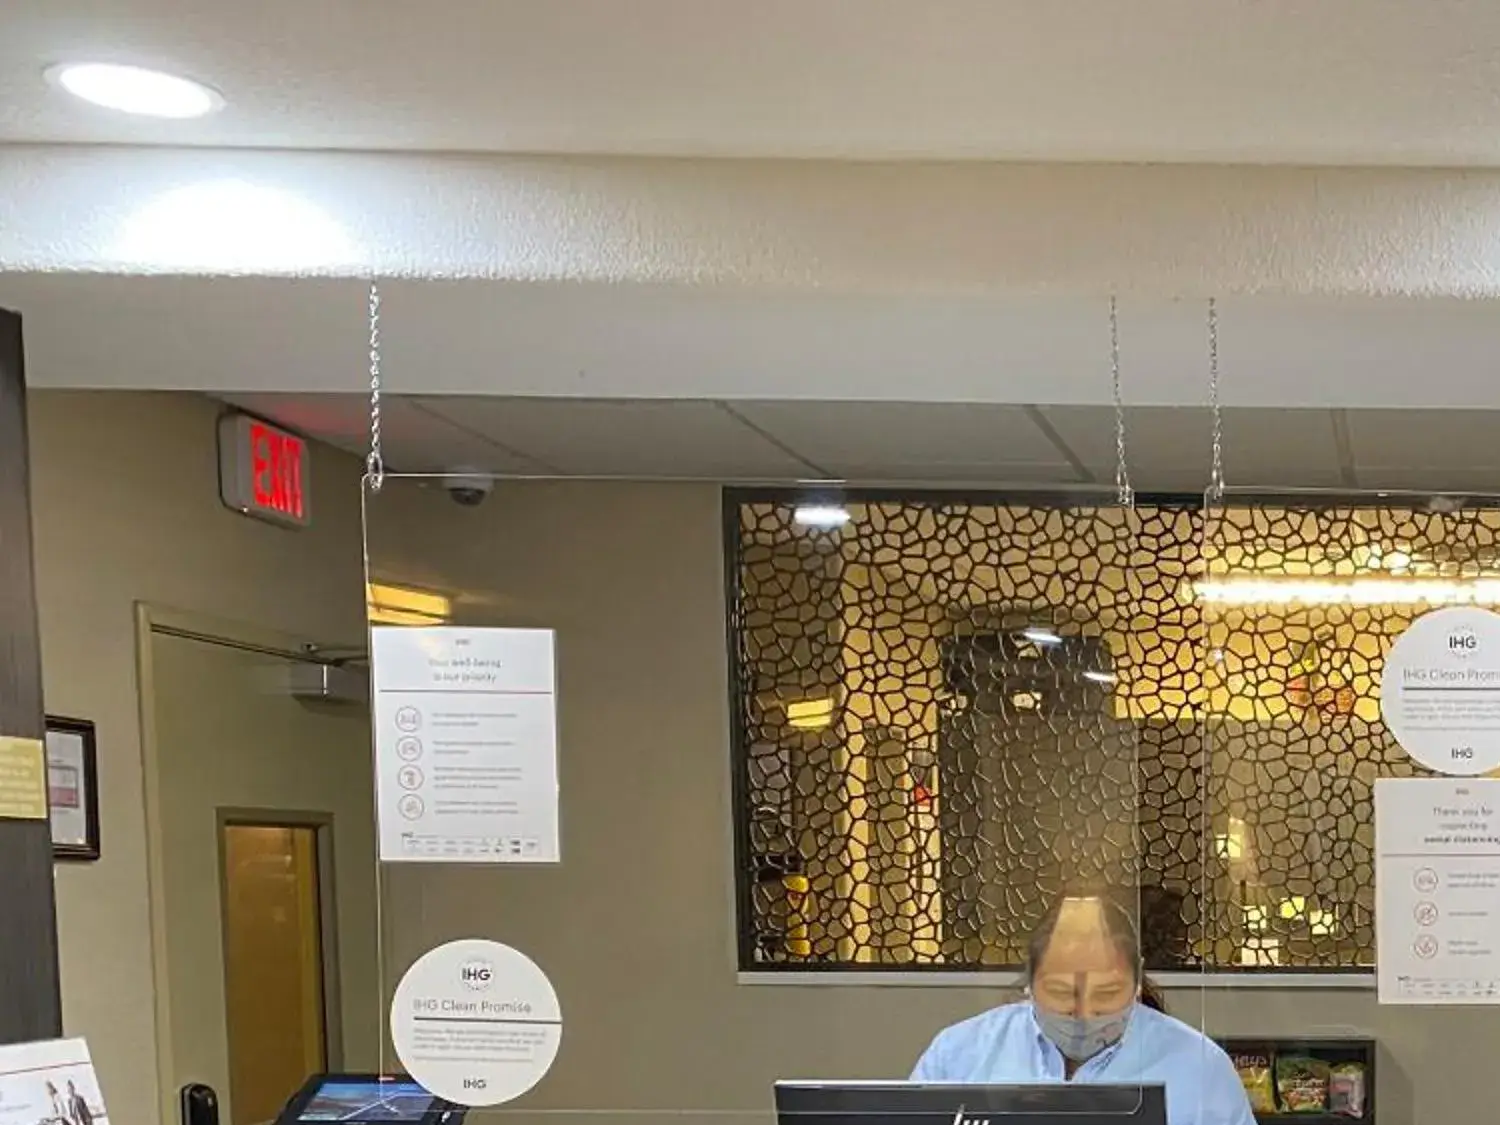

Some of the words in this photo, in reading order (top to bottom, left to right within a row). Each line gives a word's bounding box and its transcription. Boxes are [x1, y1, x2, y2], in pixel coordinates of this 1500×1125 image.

[250, 423, 303, 518] EXIT
[1450, 636, 1477, 649] IHG
[1404, 669, 1426, 682] IHG
[1429, 668, 1465, 681] Clean
[1451, 747, 1474, 759] IHG
[462, 968, 491, 981] IHG
[414, 1000, 438, 1011] IHG
[441, 1000, 477, 1013] Clean
[481, 1001, 532, 1014] Promise
[463, 1078, 487, 1089] IHG
